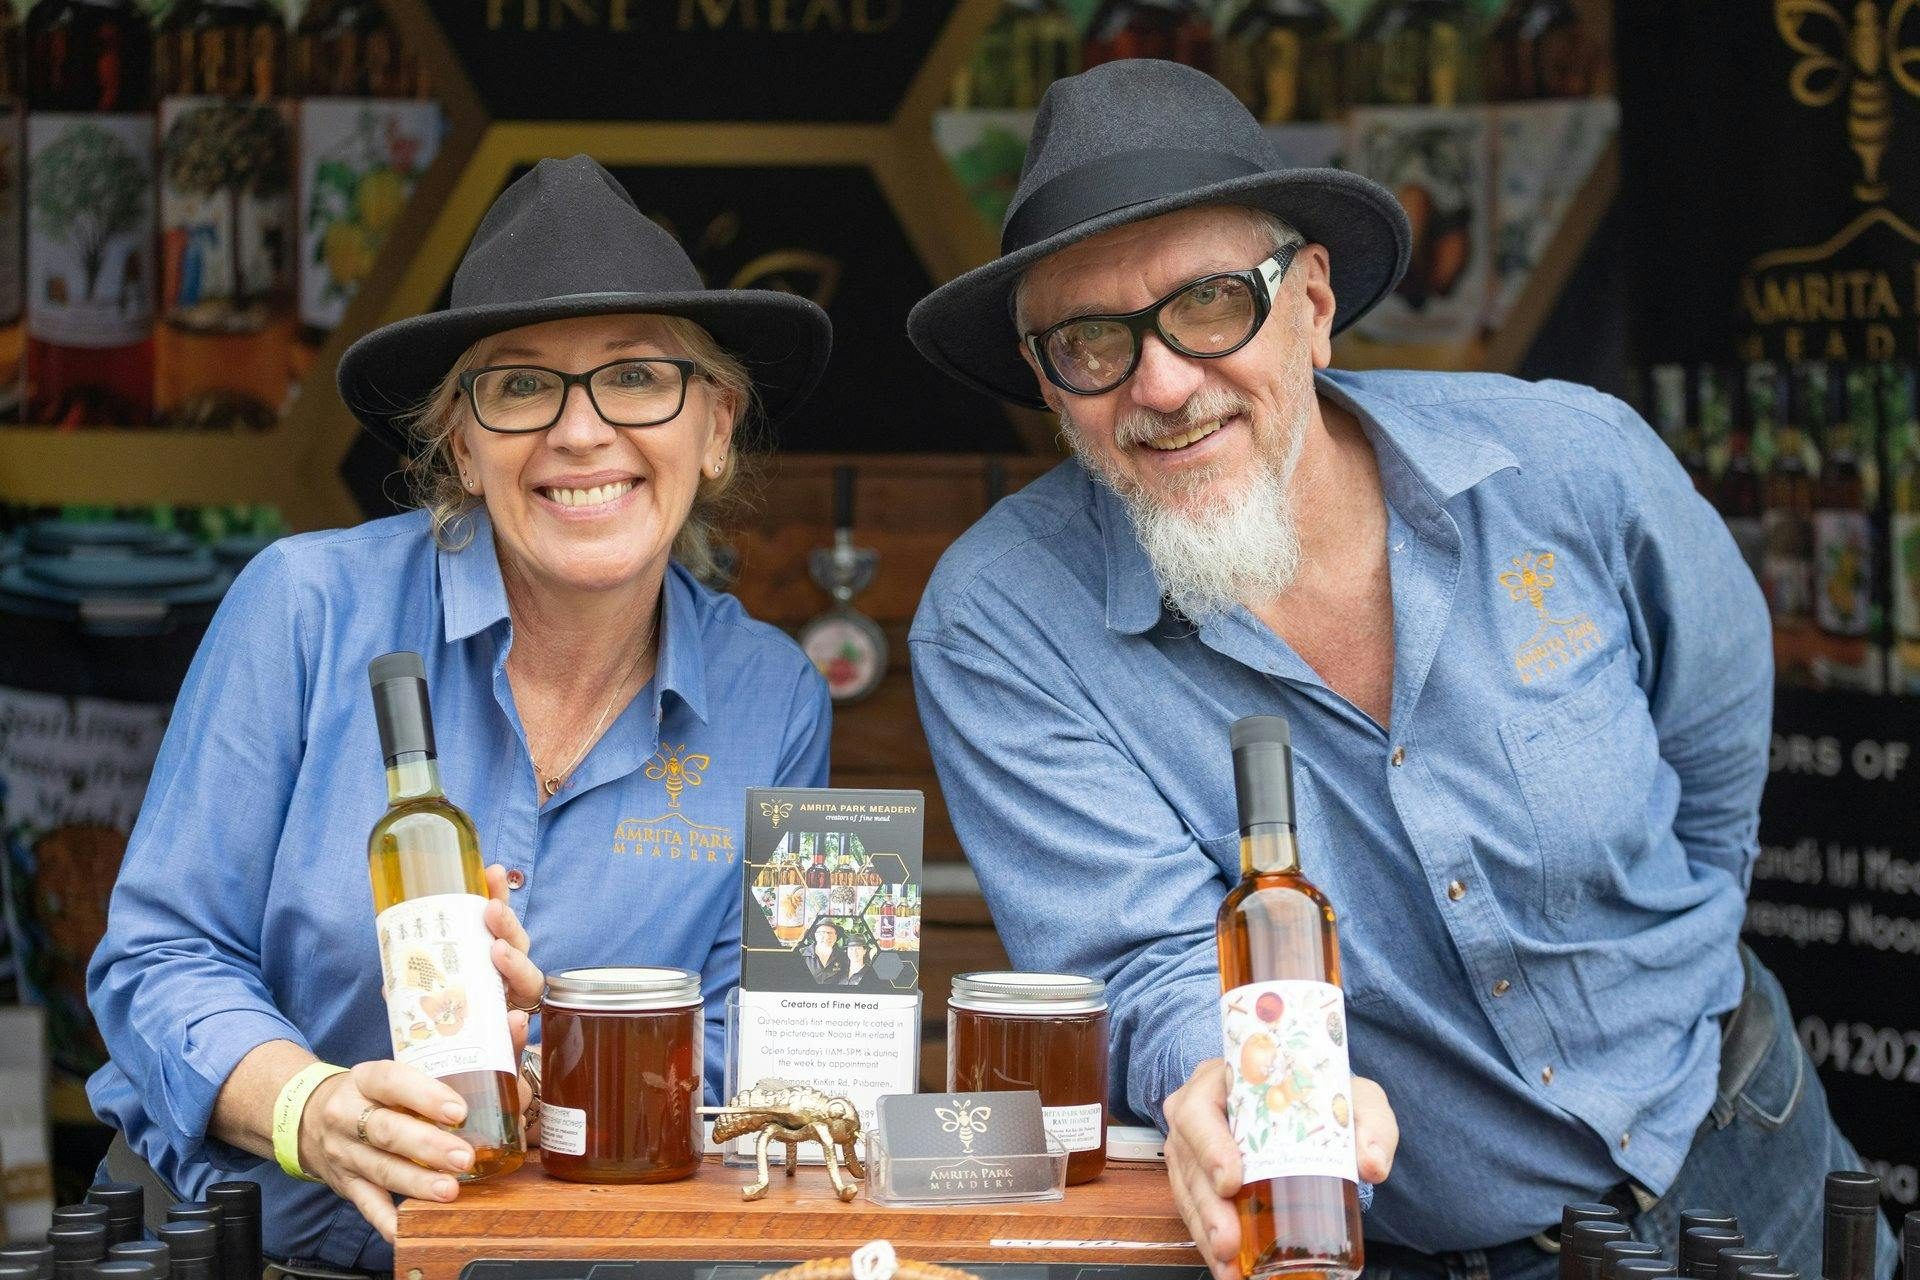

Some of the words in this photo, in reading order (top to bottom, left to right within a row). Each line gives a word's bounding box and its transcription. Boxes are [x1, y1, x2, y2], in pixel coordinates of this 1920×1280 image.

[1740, 271, 1901, 323] AMRITA
[1851, 738, 1911, 782] OF
[799, 803, 838, 812] AMRITA
[840, 804, 866, 813] PARK
[869, 805, 917, 814] MEADERY
[858, 813, 874, 823] fine
[614, 823, 683, 845] AMRITA
[688, 831, 736, 850] PARK
[613, 842, 735, 865] MEADERY
[780, 999, 818, 1009] Creators
[820, 1000, 831, 1009] of
[833, 1001, 851, 1010] Fine
[854, 1001, 879, 1010] Mead
[825, 1019, 860, 1029] meadery
[862, 1020, 894, 1028] located
[765, 1029, 778, 1037] the
[780, 1029, 825, 1039] picturesque
[760, 1045, 784, 1056] Open
[873, 1049, 899, 1059] during
[778, 1059, 791, 1067] the
[794, 1059, 815, 1068] week
[817, 1059, 826, 1069] by
[929, 1170, 978, 1181] AMRITA
[981, 1168, 1014, 1180] PARK
[930, 1179, 1015, 1191] MEADERY
